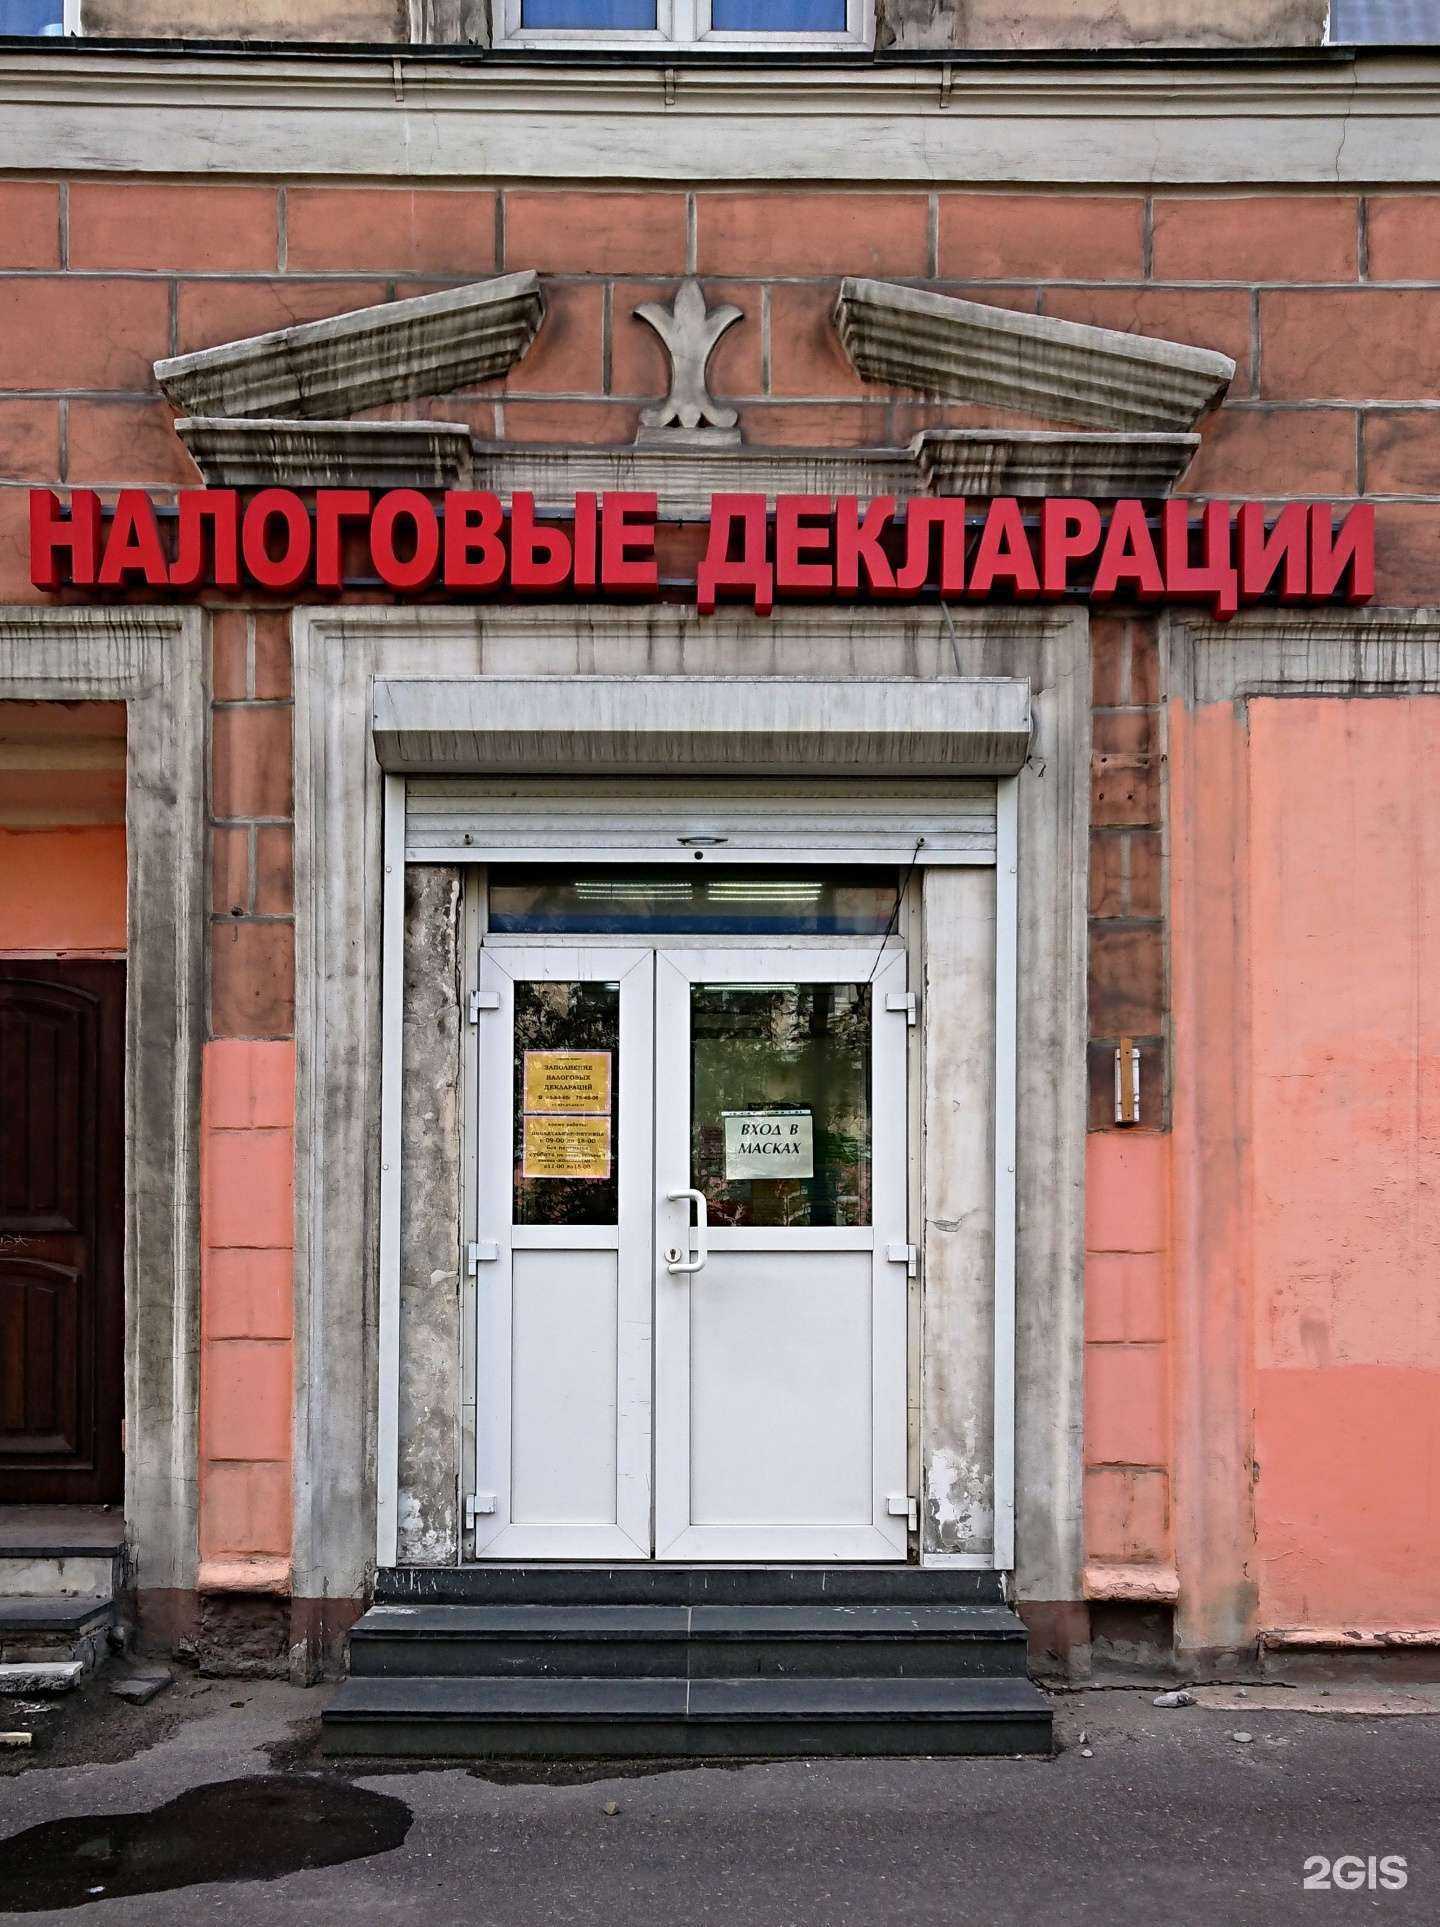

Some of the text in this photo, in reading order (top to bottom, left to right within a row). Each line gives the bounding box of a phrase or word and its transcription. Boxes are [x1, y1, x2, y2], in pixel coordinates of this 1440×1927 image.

[29, 489, 1375, 621] НАЛОГОВЫЕ ДЕКЛАРАЦИИ
[741, 1123, 799, 1136] ВХОД В
[738, 1142, 802, 1155] МАСКАХ
